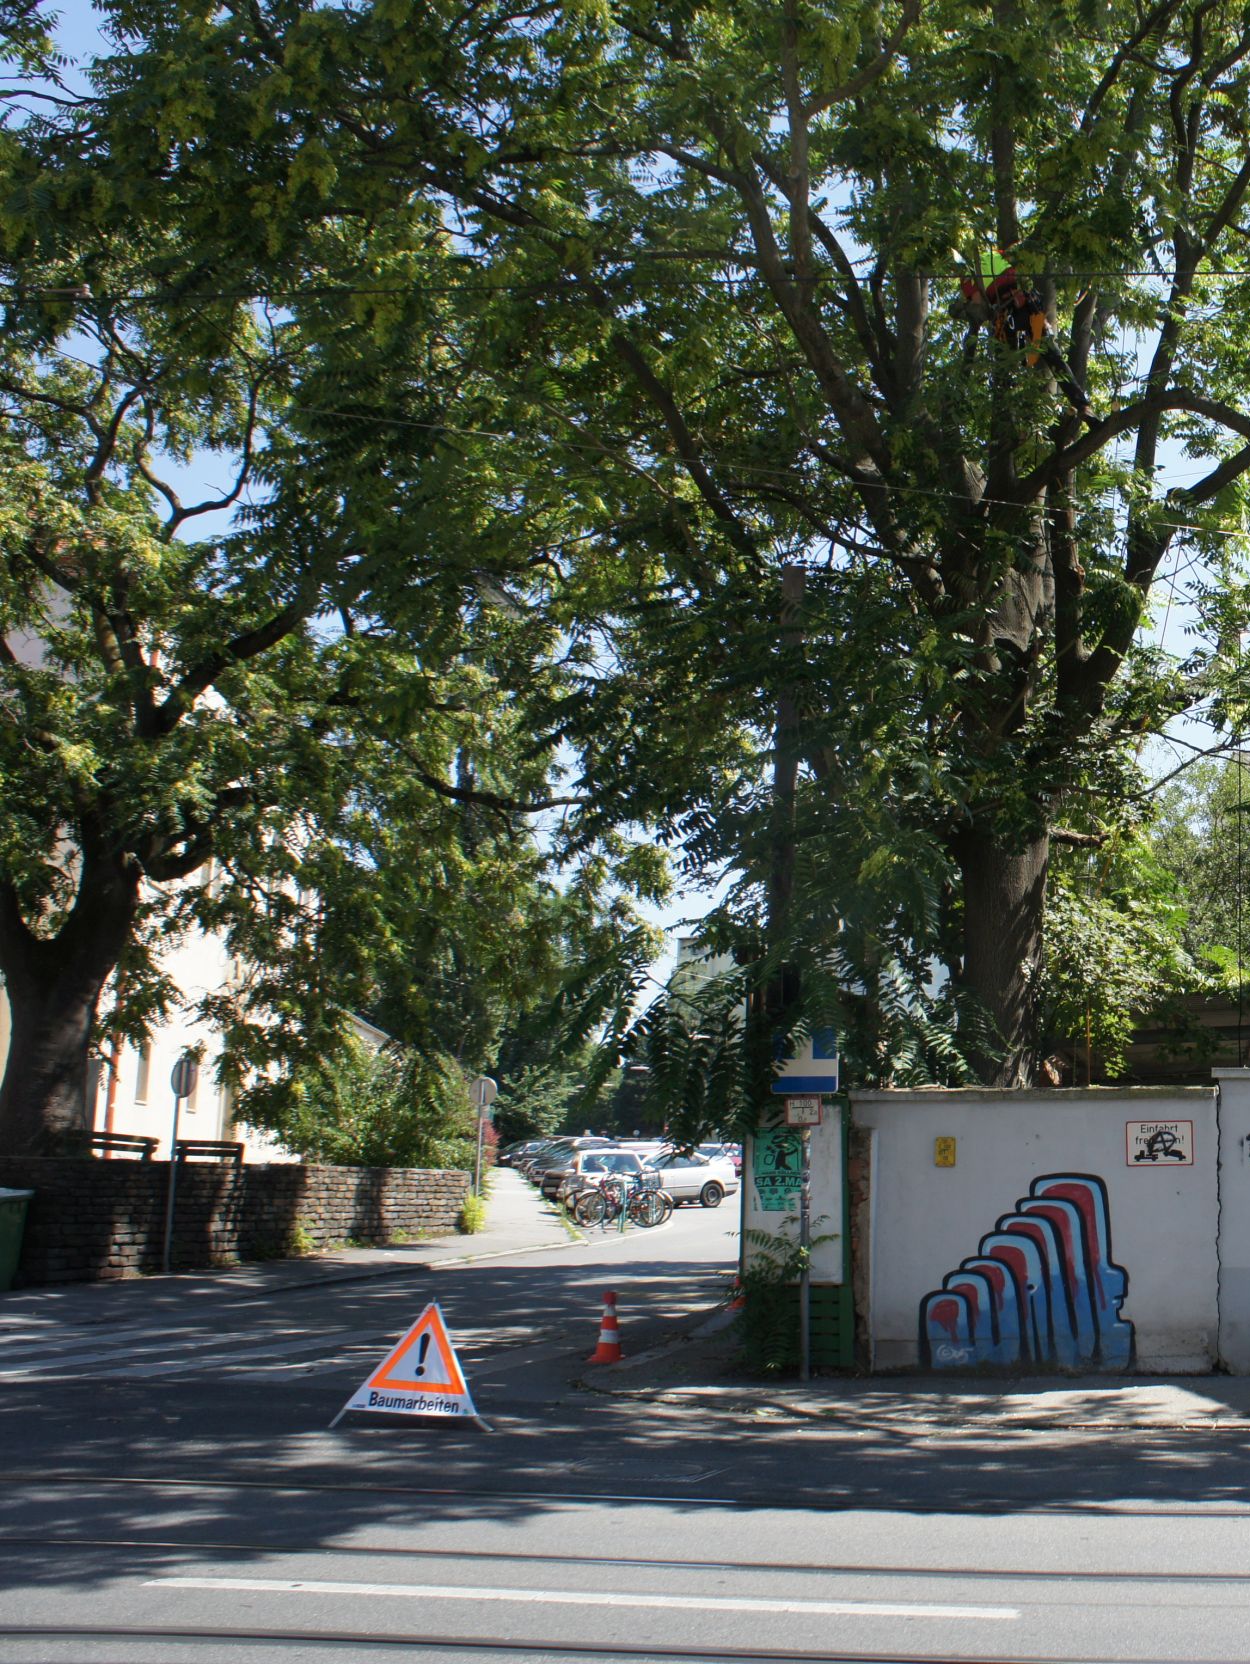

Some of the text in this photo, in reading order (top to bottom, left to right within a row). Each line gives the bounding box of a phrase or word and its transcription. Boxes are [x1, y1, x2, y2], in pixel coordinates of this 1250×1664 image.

[1140, 1123, 1178, 1133] Einfahrt
[756, 1176, 771, 1186] SA
[368, 1391, 459, 1413] Baumarbeiten
